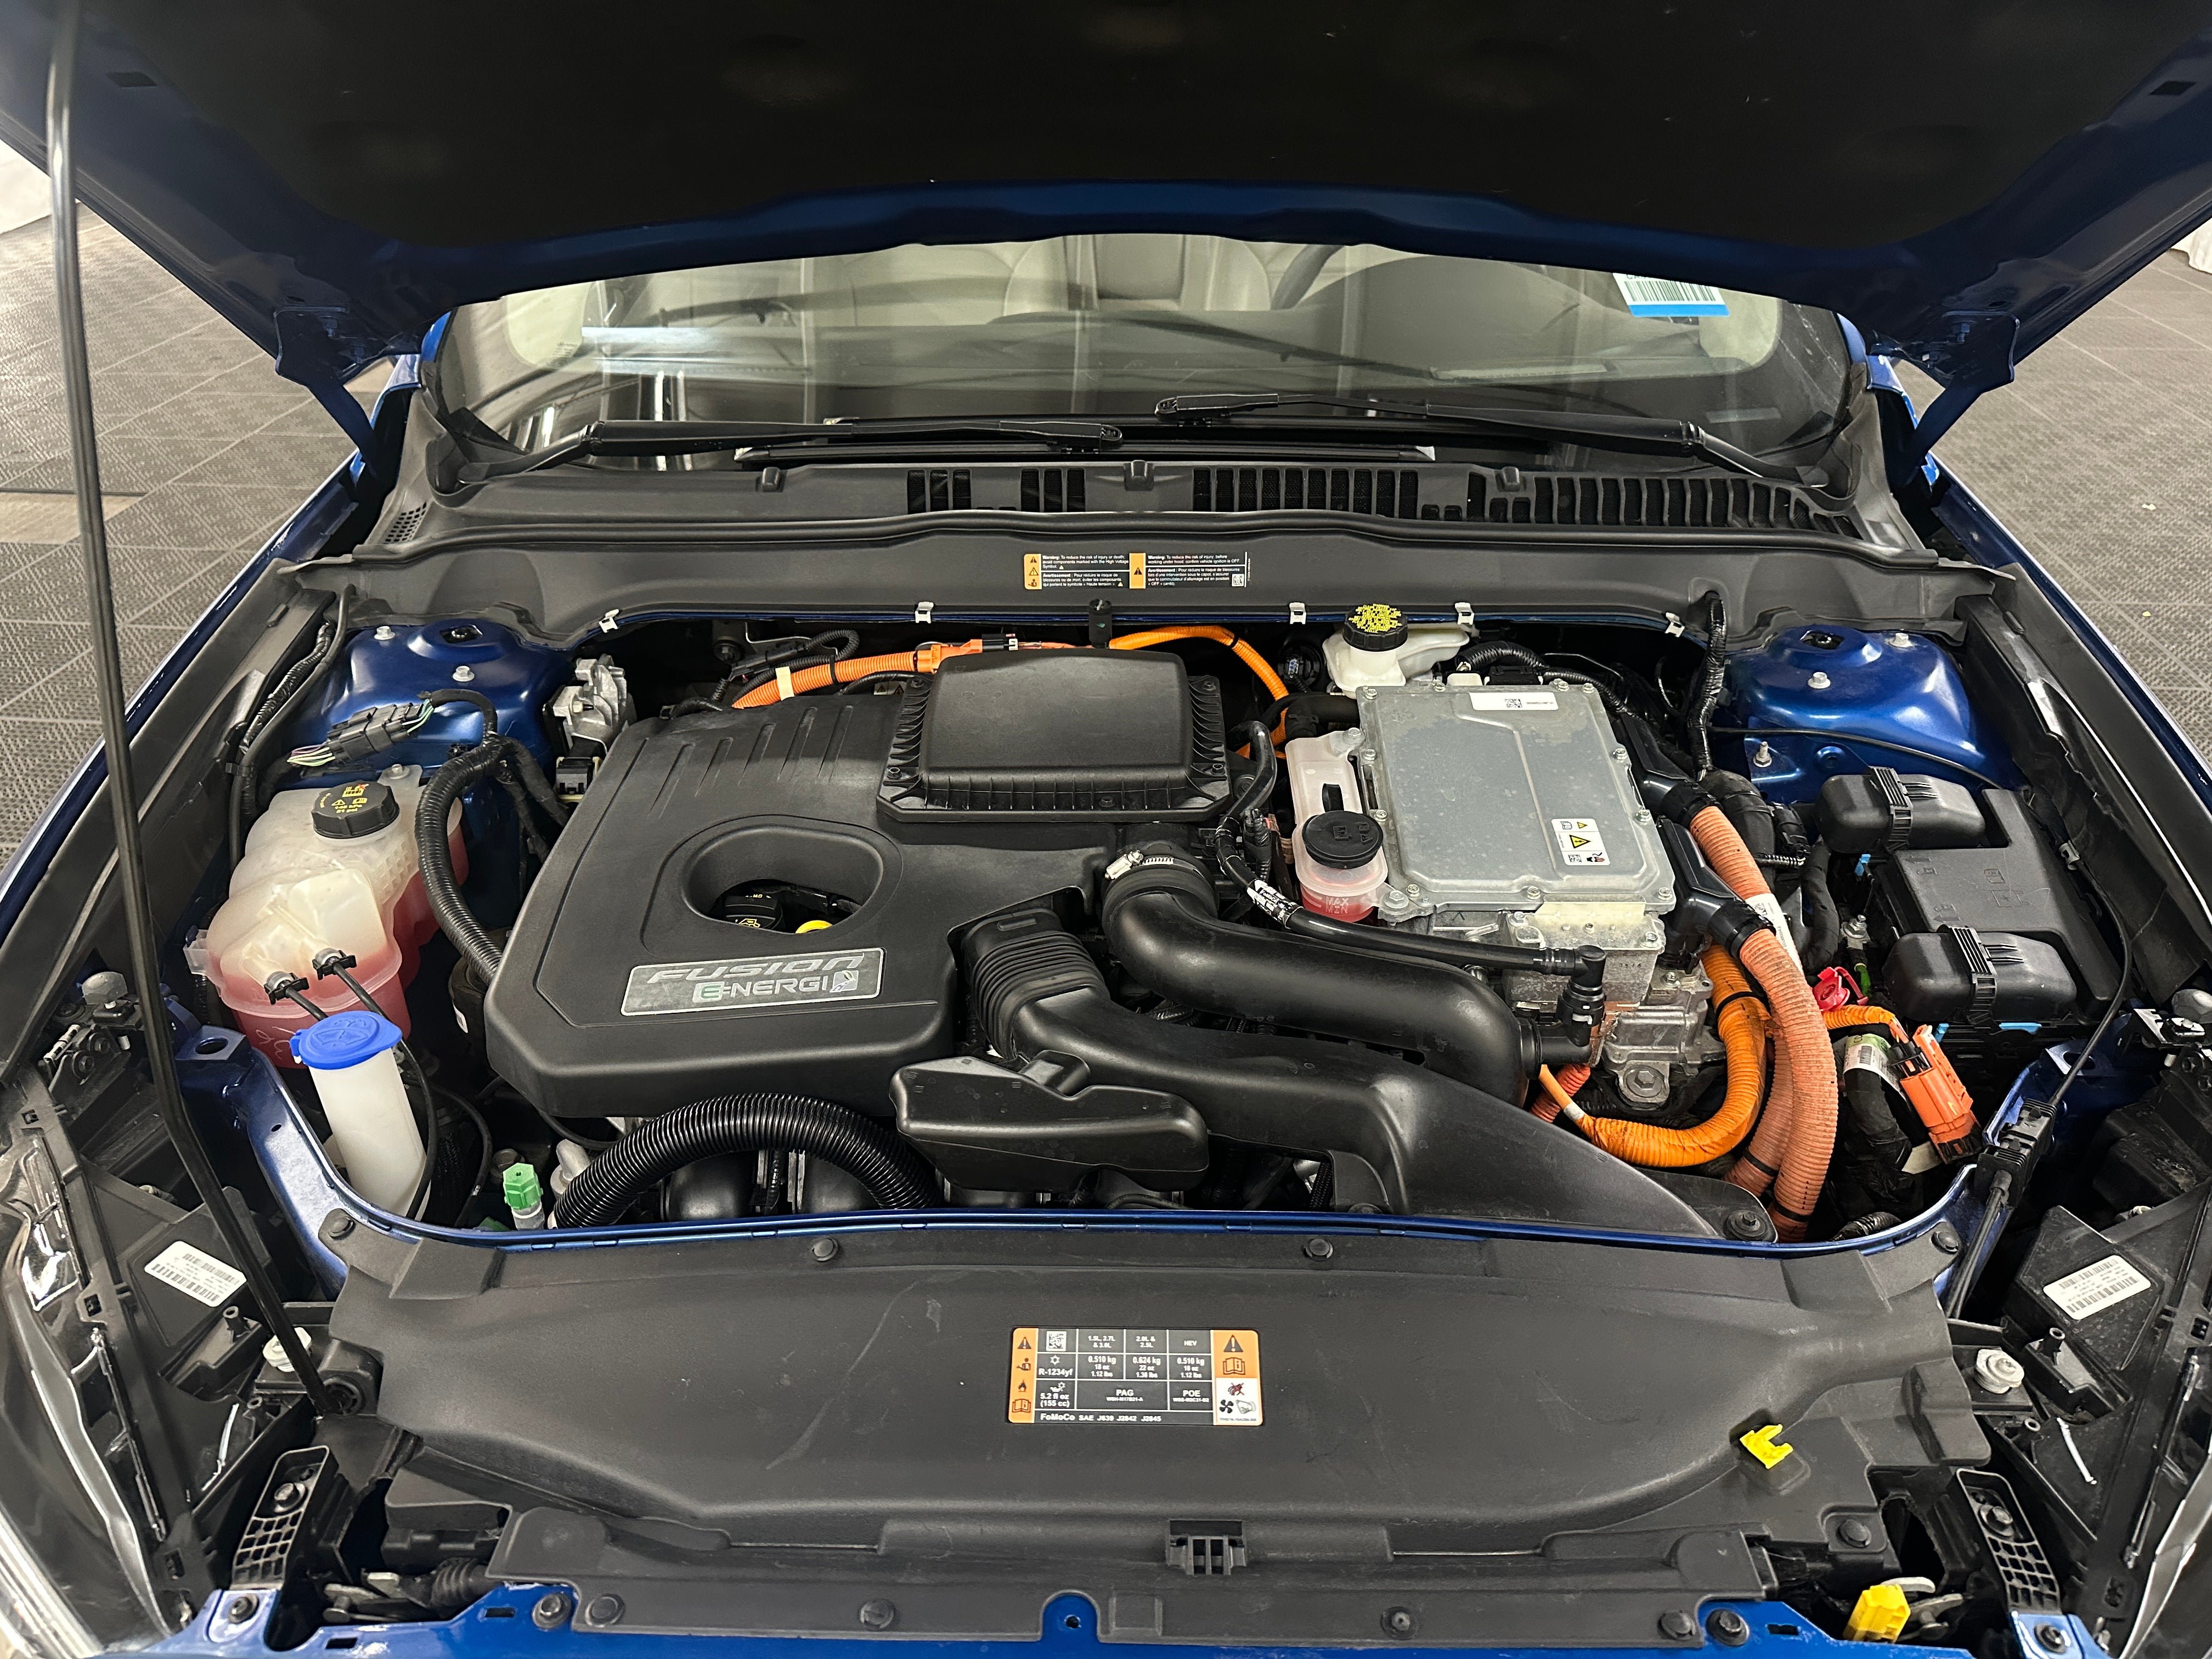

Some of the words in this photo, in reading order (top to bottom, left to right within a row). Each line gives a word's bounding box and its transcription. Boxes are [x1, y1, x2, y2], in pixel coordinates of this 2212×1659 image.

[1325, 896, 1349, 906] MAX
[647, 952, 865, 984] FUSION
[1107, 1356, 1116, 1365] kg
[1152, 1356, 1161, 1365] kg
[1196, 1357, 1205, 1366] kg
[1038, 1368, 1074, 1377] R-1234yf
[1040, 1400, 1057, 1408] (155
[1040, 1413, 1075, 1421] FoMoCo
